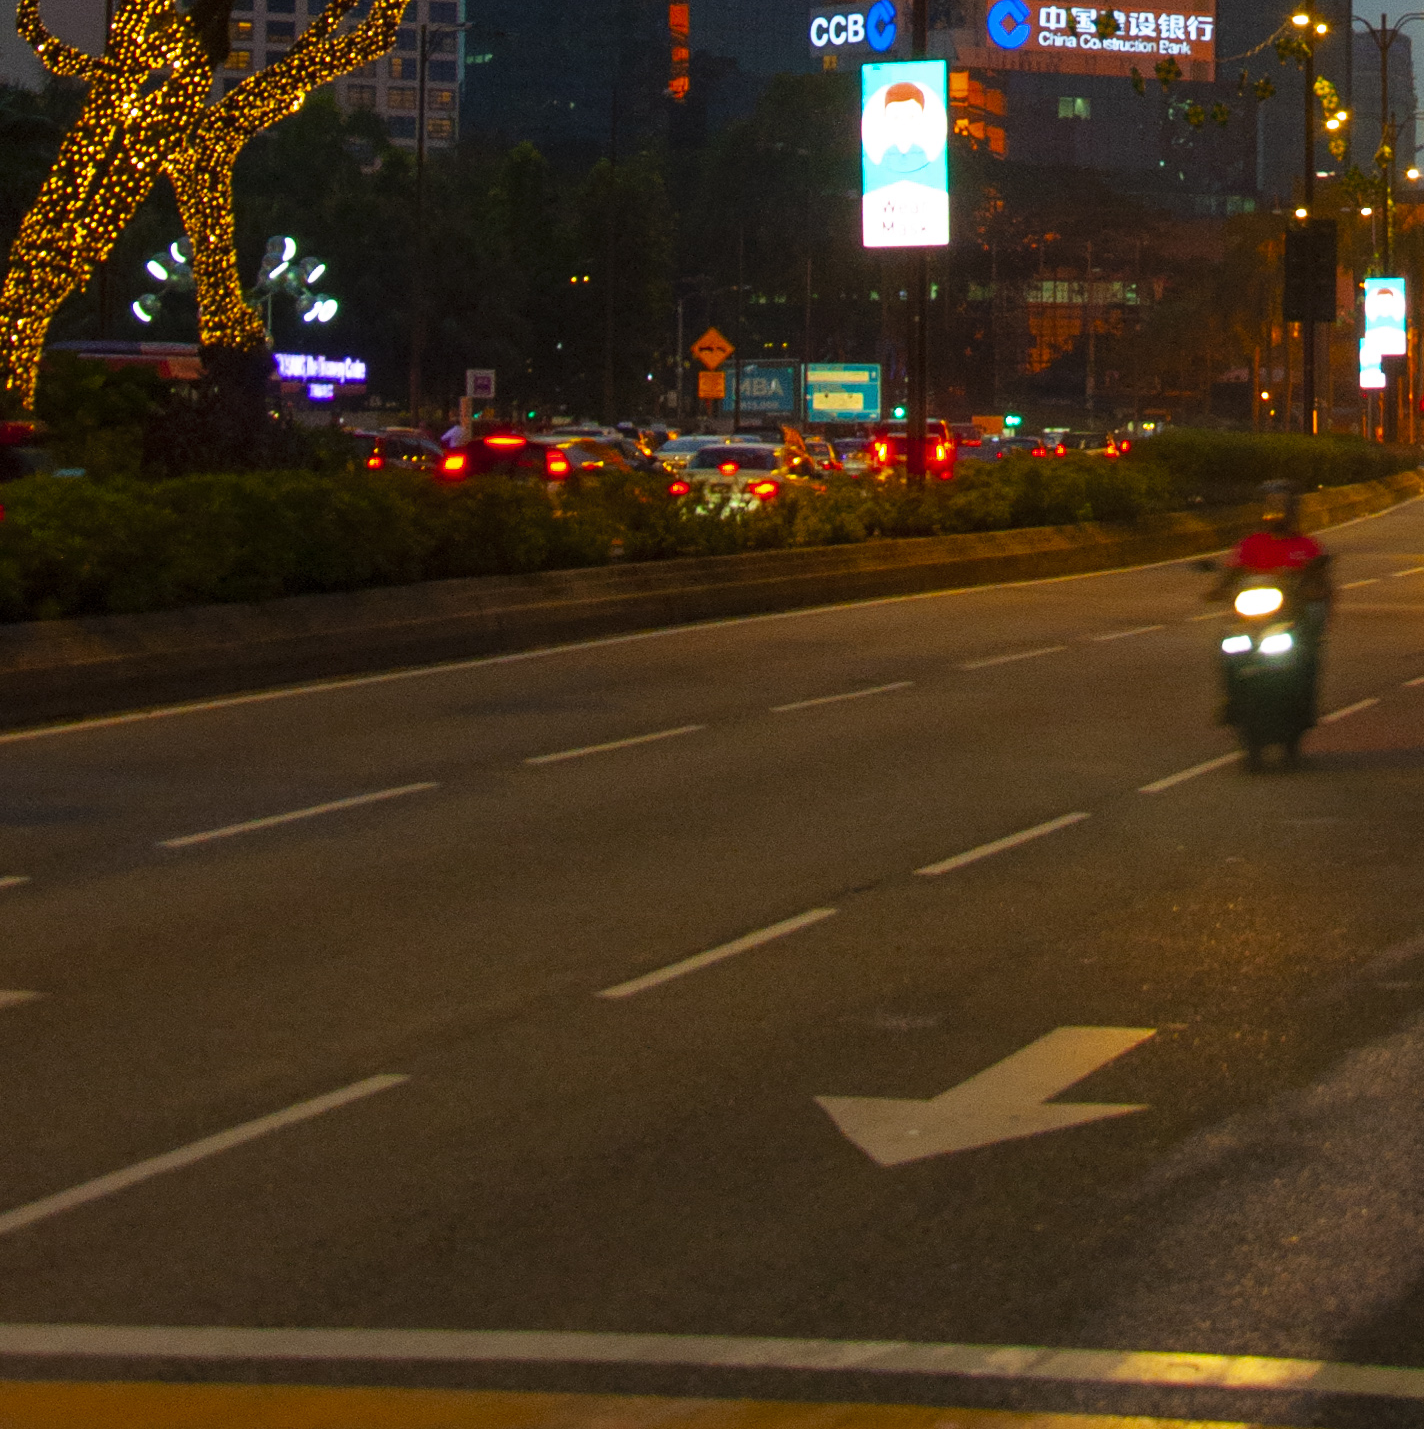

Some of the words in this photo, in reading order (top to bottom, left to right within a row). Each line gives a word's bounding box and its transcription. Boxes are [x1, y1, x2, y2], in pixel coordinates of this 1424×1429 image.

[810, 13, 865, 47] CCB
[1038, 31, 1077, 48] China
[1159, 39, 1191, 55] Bank
